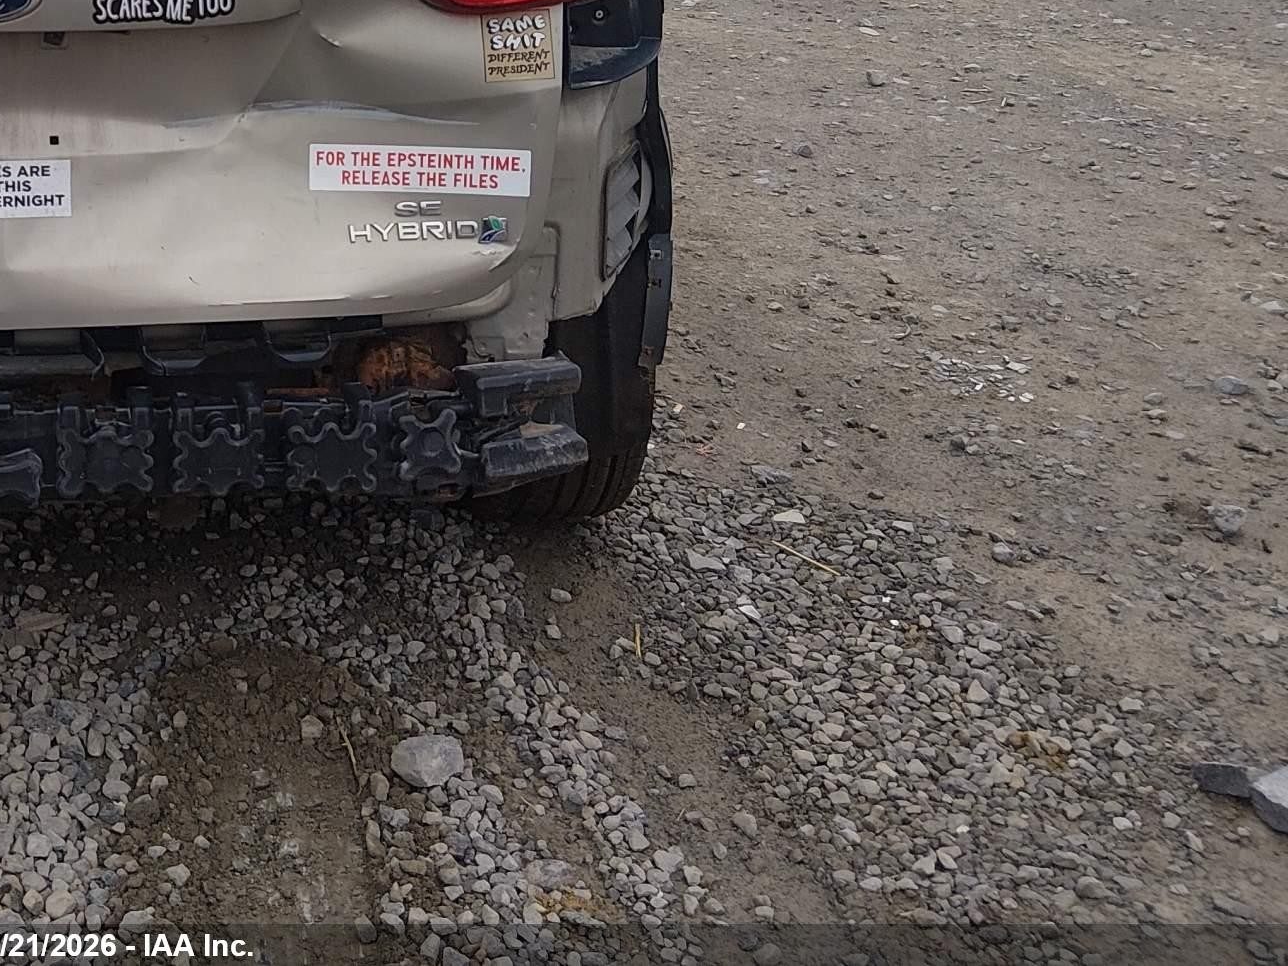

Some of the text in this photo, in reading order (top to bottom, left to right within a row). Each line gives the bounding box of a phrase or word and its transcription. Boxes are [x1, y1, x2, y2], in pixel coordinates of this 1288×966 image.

[487, 14, 546, 34] SAME
[490, 32, 546, 51] SHIT
[487, 48, 551, 64] DIFFERENT
[487, 61, 551, 77] PRESIDENT
[17, 165, 51, 178] ARE
[316, 151, 526, 173] FOR THE EPSTEINTH TIME,
[341, 170, 499, 189] RELEASE THE FILES
[394, 200, 443, 217] SE
[348, 220, 480, 243] HYBRID
